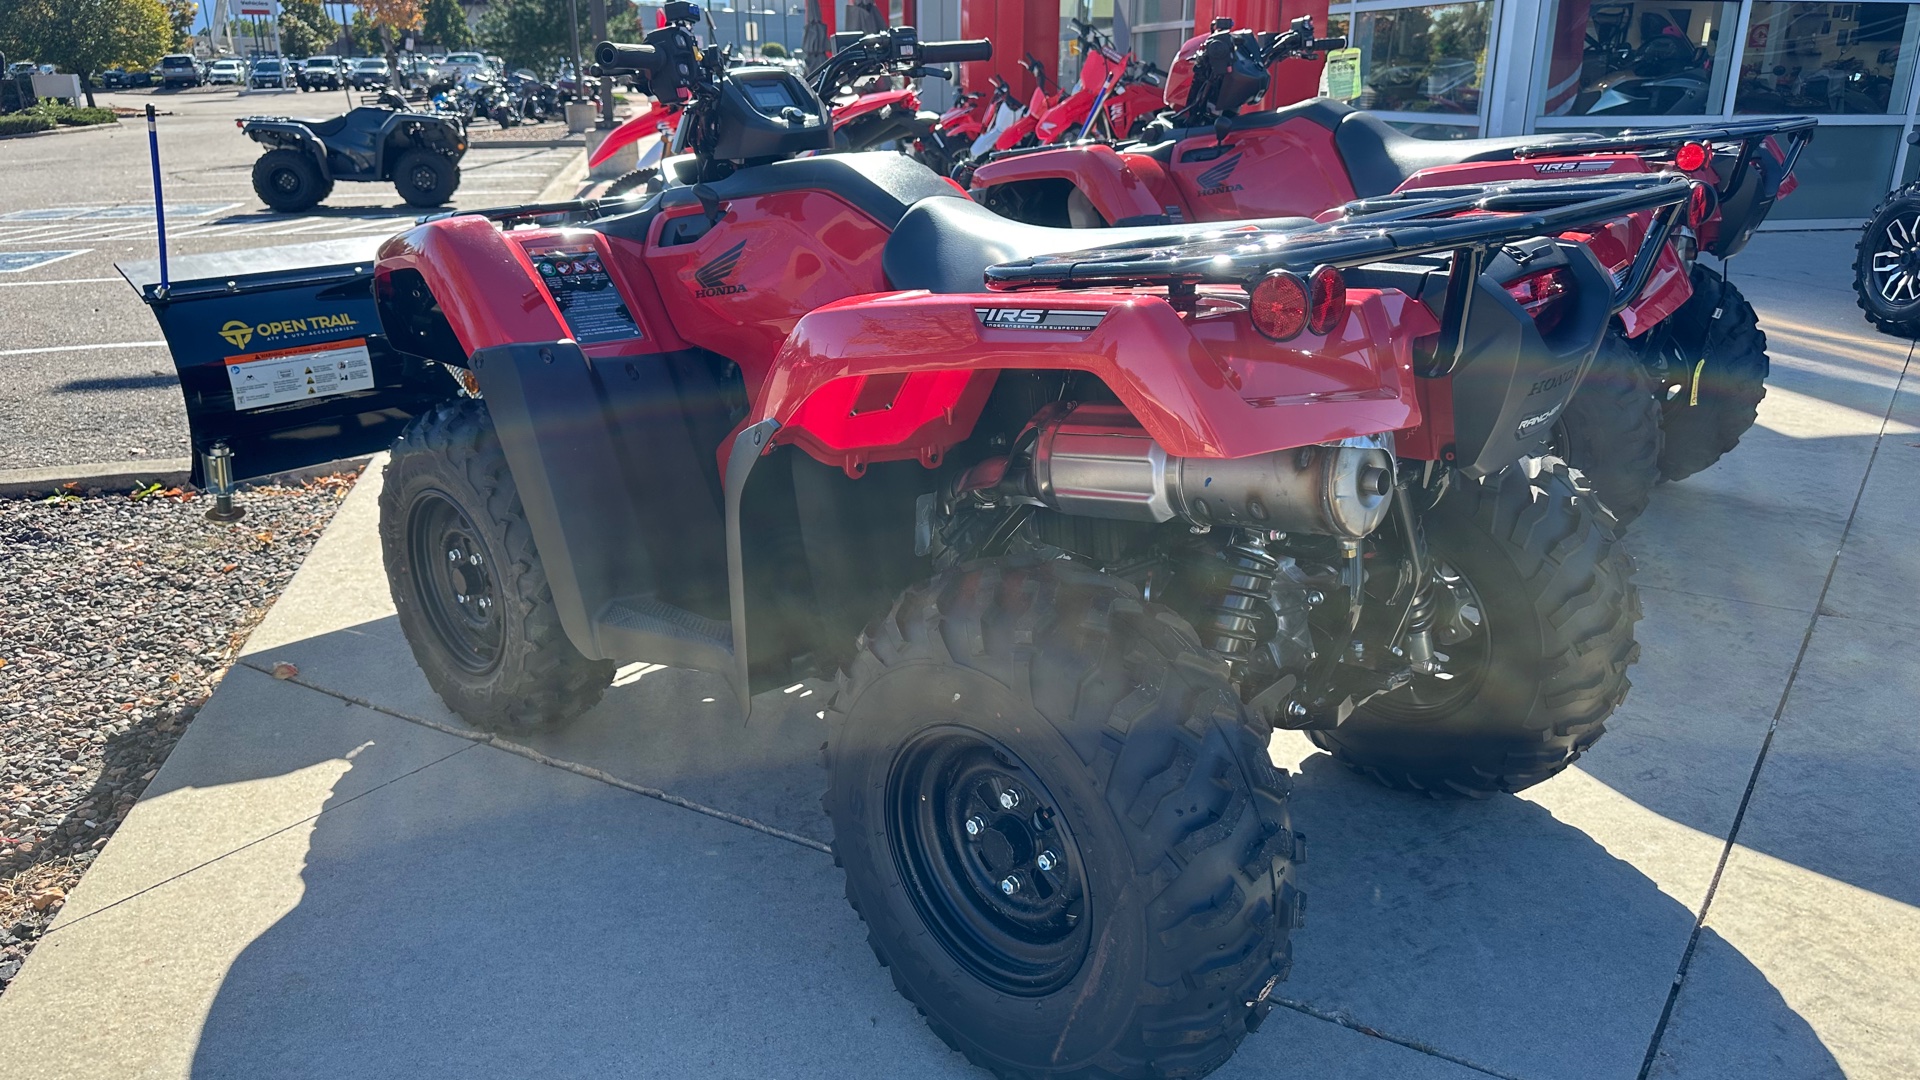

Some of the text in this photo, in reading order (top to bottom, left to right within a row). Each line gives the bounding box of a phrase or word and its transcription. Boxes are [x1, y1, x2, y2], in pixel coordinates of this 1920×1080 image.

[1541, 162, 1577, 170] IRS
[1197, 183, 1245, 197] HONDA
[695, 284, 748, 298] HONDA
[986, 308, 1043, 323] IRS
[256, 313, 357, 337] OPEN TRAIL
[308, 325, 354, 336] ACCESSORIES
